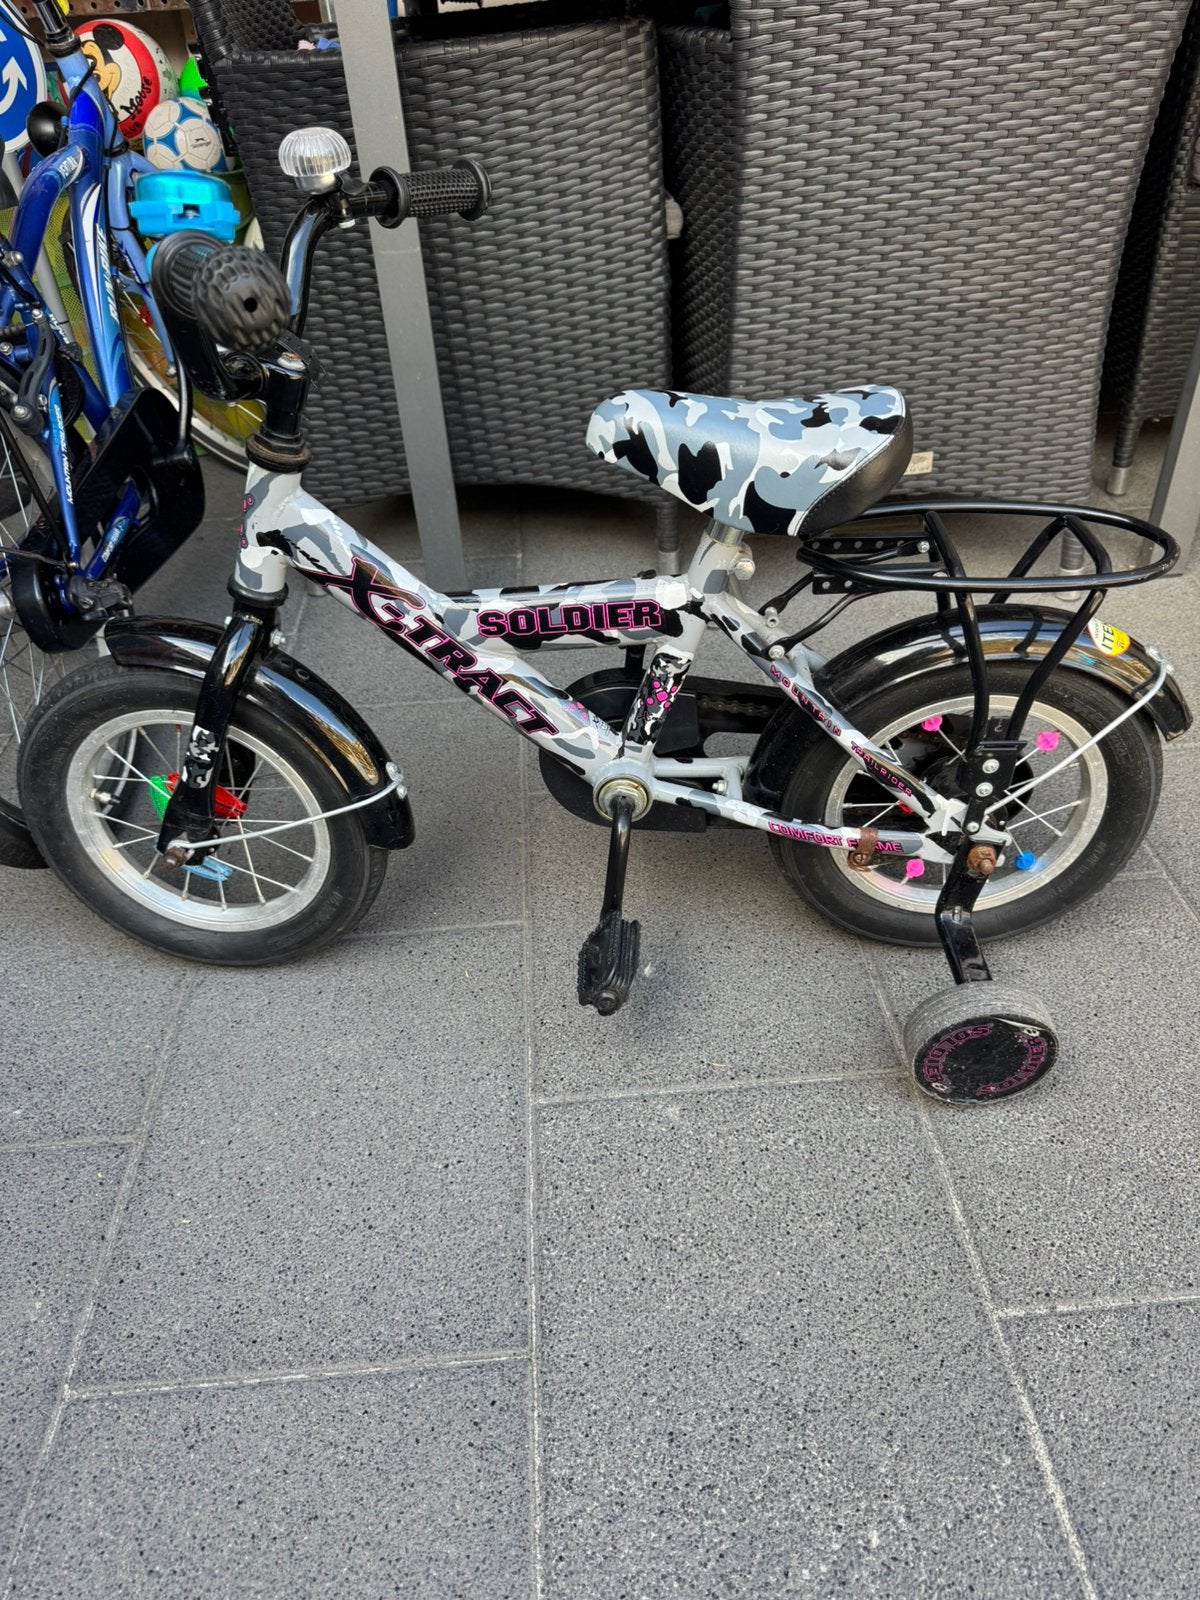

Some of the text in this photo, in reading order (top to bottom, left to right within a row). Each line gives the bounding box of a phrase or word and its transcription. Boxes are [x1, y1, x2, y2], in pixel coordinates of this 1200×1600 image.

[476, 599, 662, 638] SOLDIER
[769, 664, 843, 738] MOUNTAIN
[768, 821, 904, 854] COMFORT FME
[922, 1022, 995, 1084] SOLDIER
